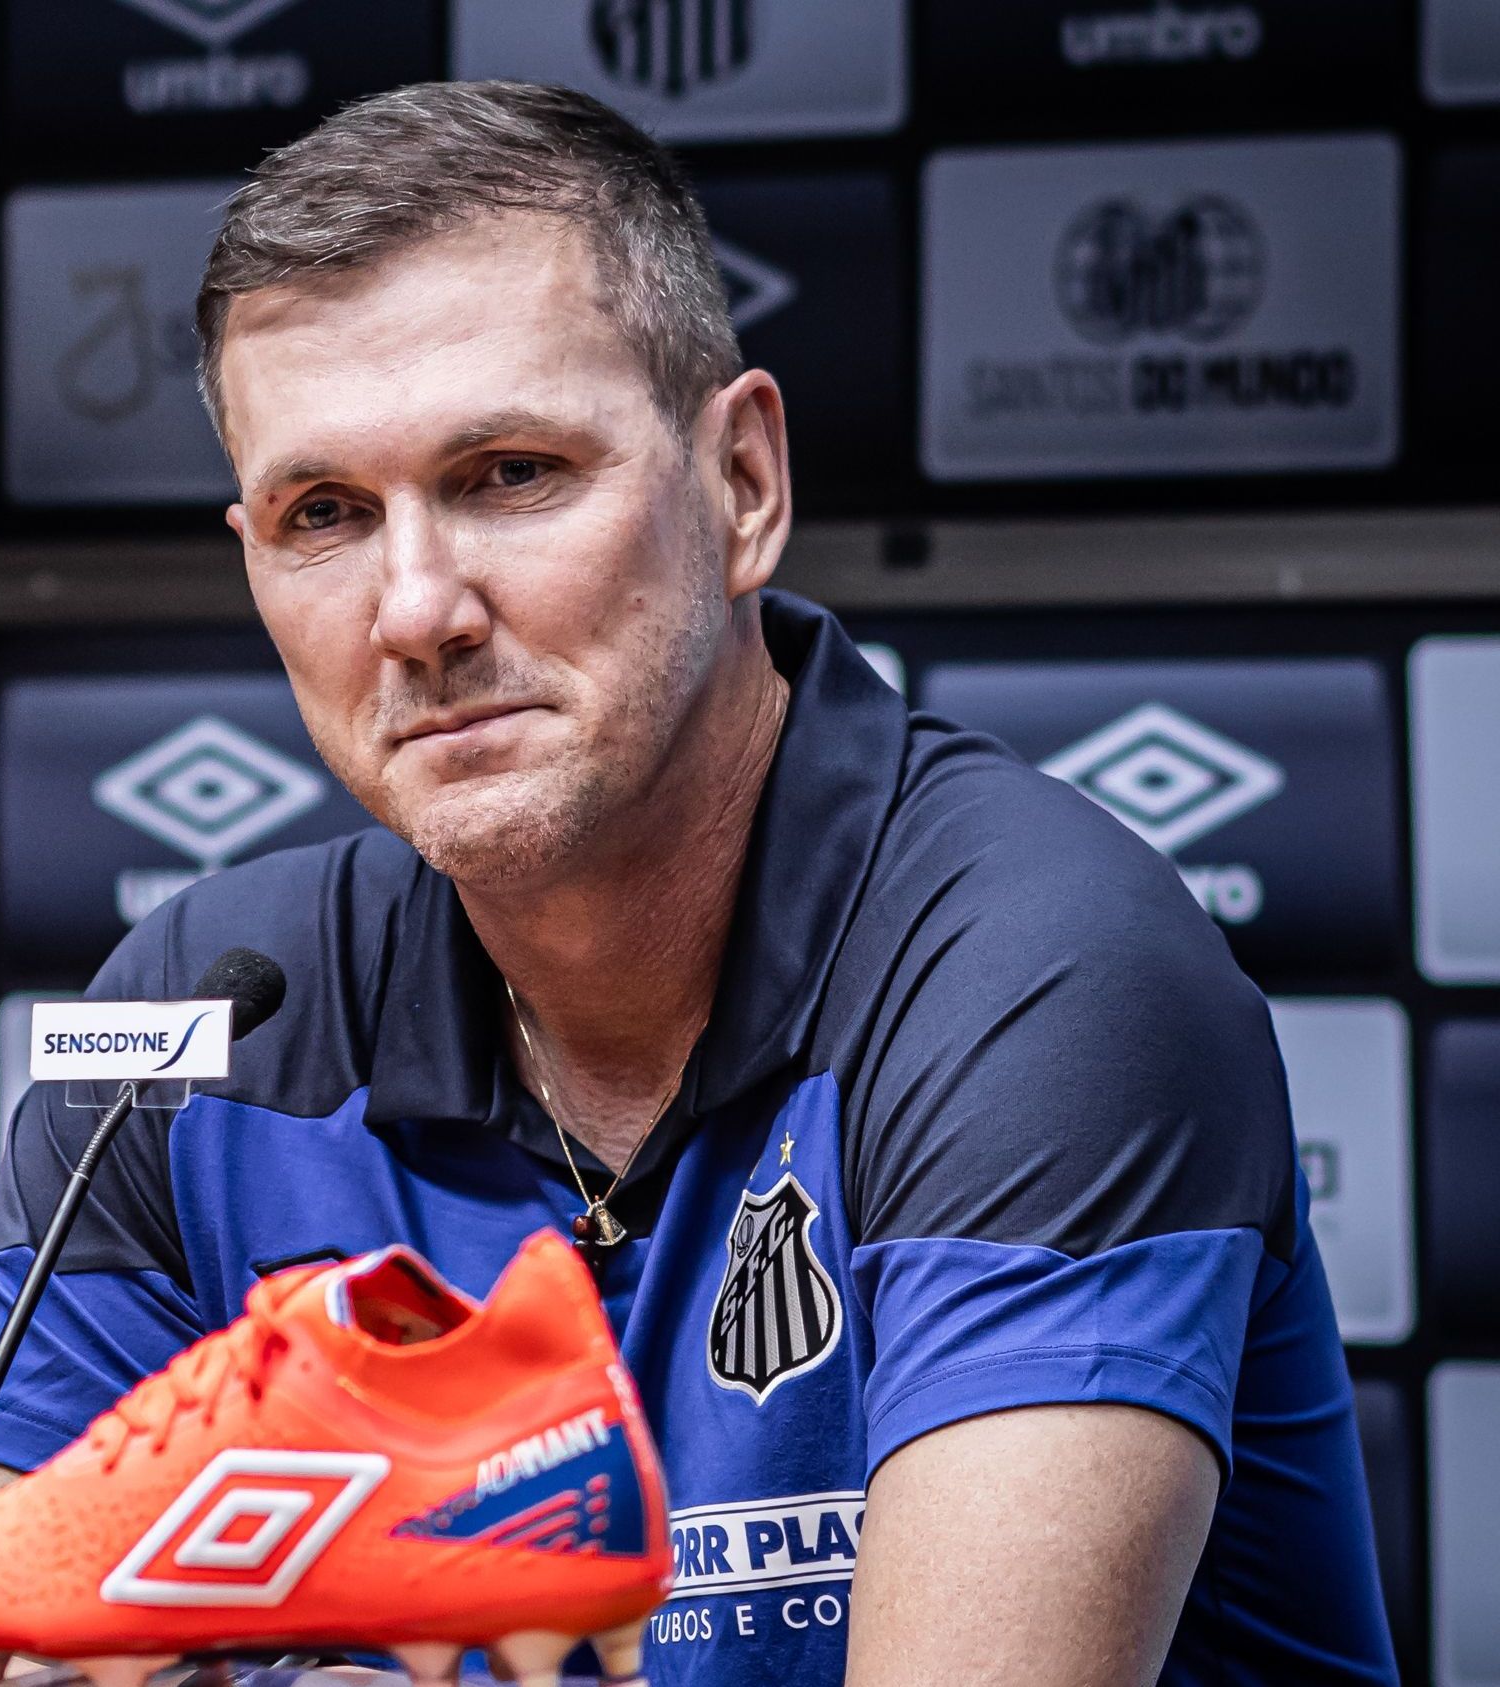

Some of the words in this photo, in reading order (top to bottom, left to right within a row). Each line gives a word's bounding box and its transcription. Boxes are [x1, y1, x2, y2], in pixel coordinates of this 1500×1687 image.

[1062, 4, 1261, 64] umbro
[122, 52, 310, 114] umbro
[1132, 353, 1190, 413] DO
[1203, 347, 1356, 409] MUNDO
[43, 1031, 169, 1054] SENSODYNE
[474, 1405, 611, 1502] ADAMANT
[744, 1508, 867, 1572] PLA
[650, 1607, 713, 1645] TUBOS
[735, 1604, 756, 1637] E
[781, 1593, 852, 1630] CO
